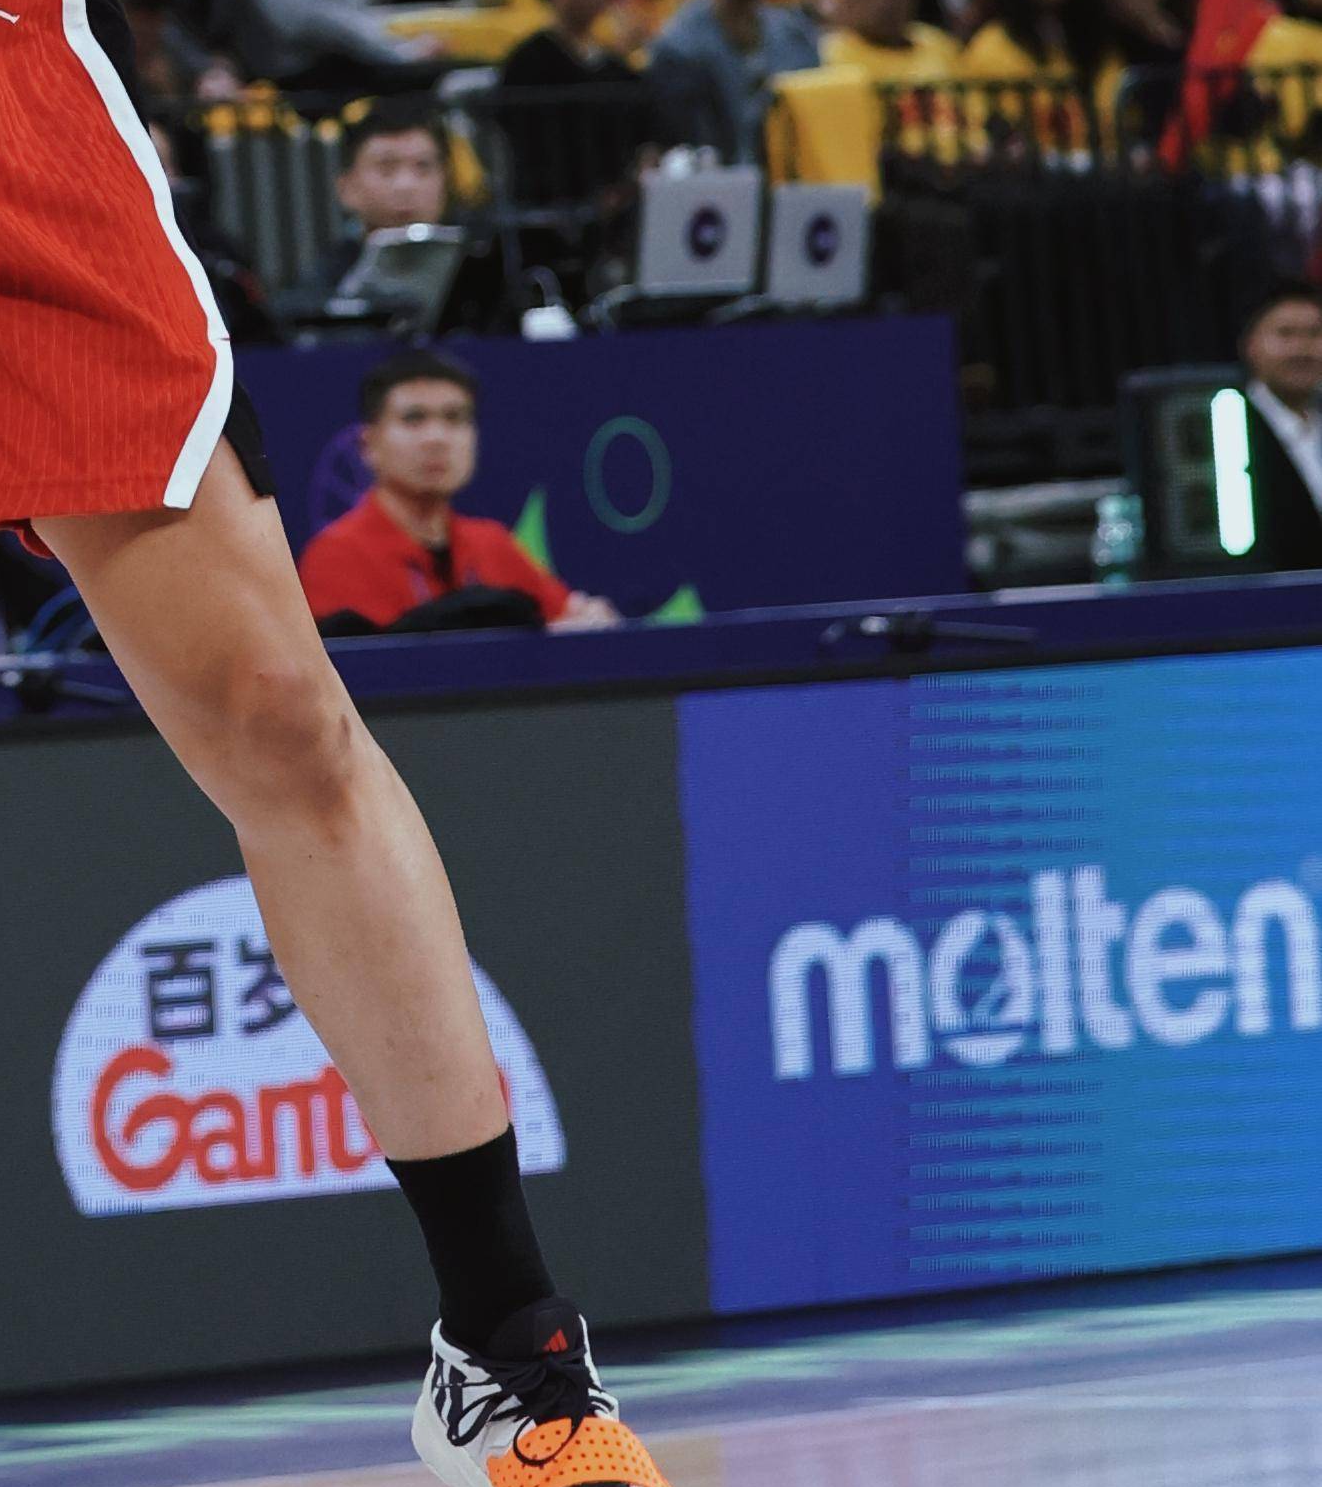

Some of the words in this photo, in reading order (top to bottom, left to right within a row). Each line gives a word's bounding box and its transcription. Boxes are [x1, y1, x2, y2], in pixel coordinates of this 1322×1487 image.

[142, 936, 302, 1039] 百岁
[769, 865, 1322, 1081] molten
[91, 1041, 513, 1192] Gant
